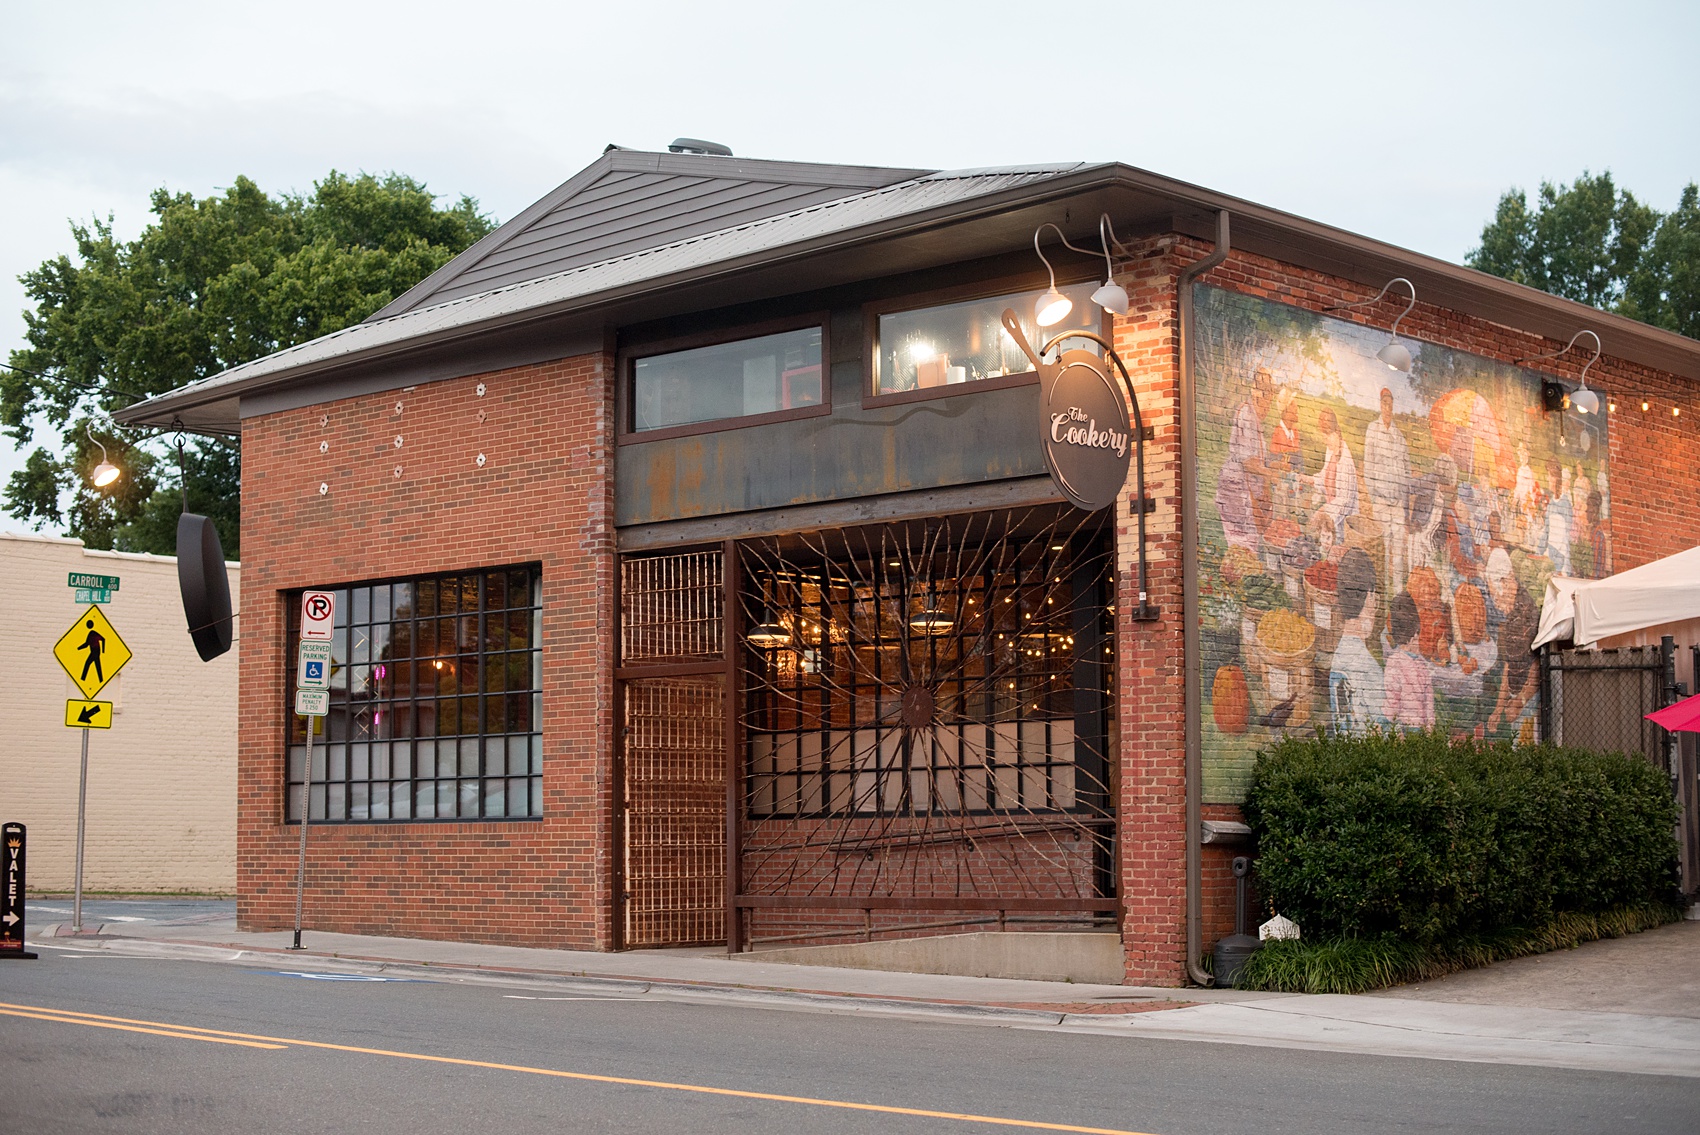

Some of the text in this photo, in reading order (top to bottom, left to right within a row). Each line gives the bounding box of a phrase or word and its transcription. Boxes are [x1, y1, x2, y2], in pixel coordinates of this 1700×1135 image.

[1067, 406, 1088, 423] The
[1050, 412, 1127, 458] Cookery
[70, 575, 104, 587] CARROLL
[302, 644, 330, 652] RESERVED
[302, 652, 328, 660] PARKING
[8, 847, 19, 907] VALET
